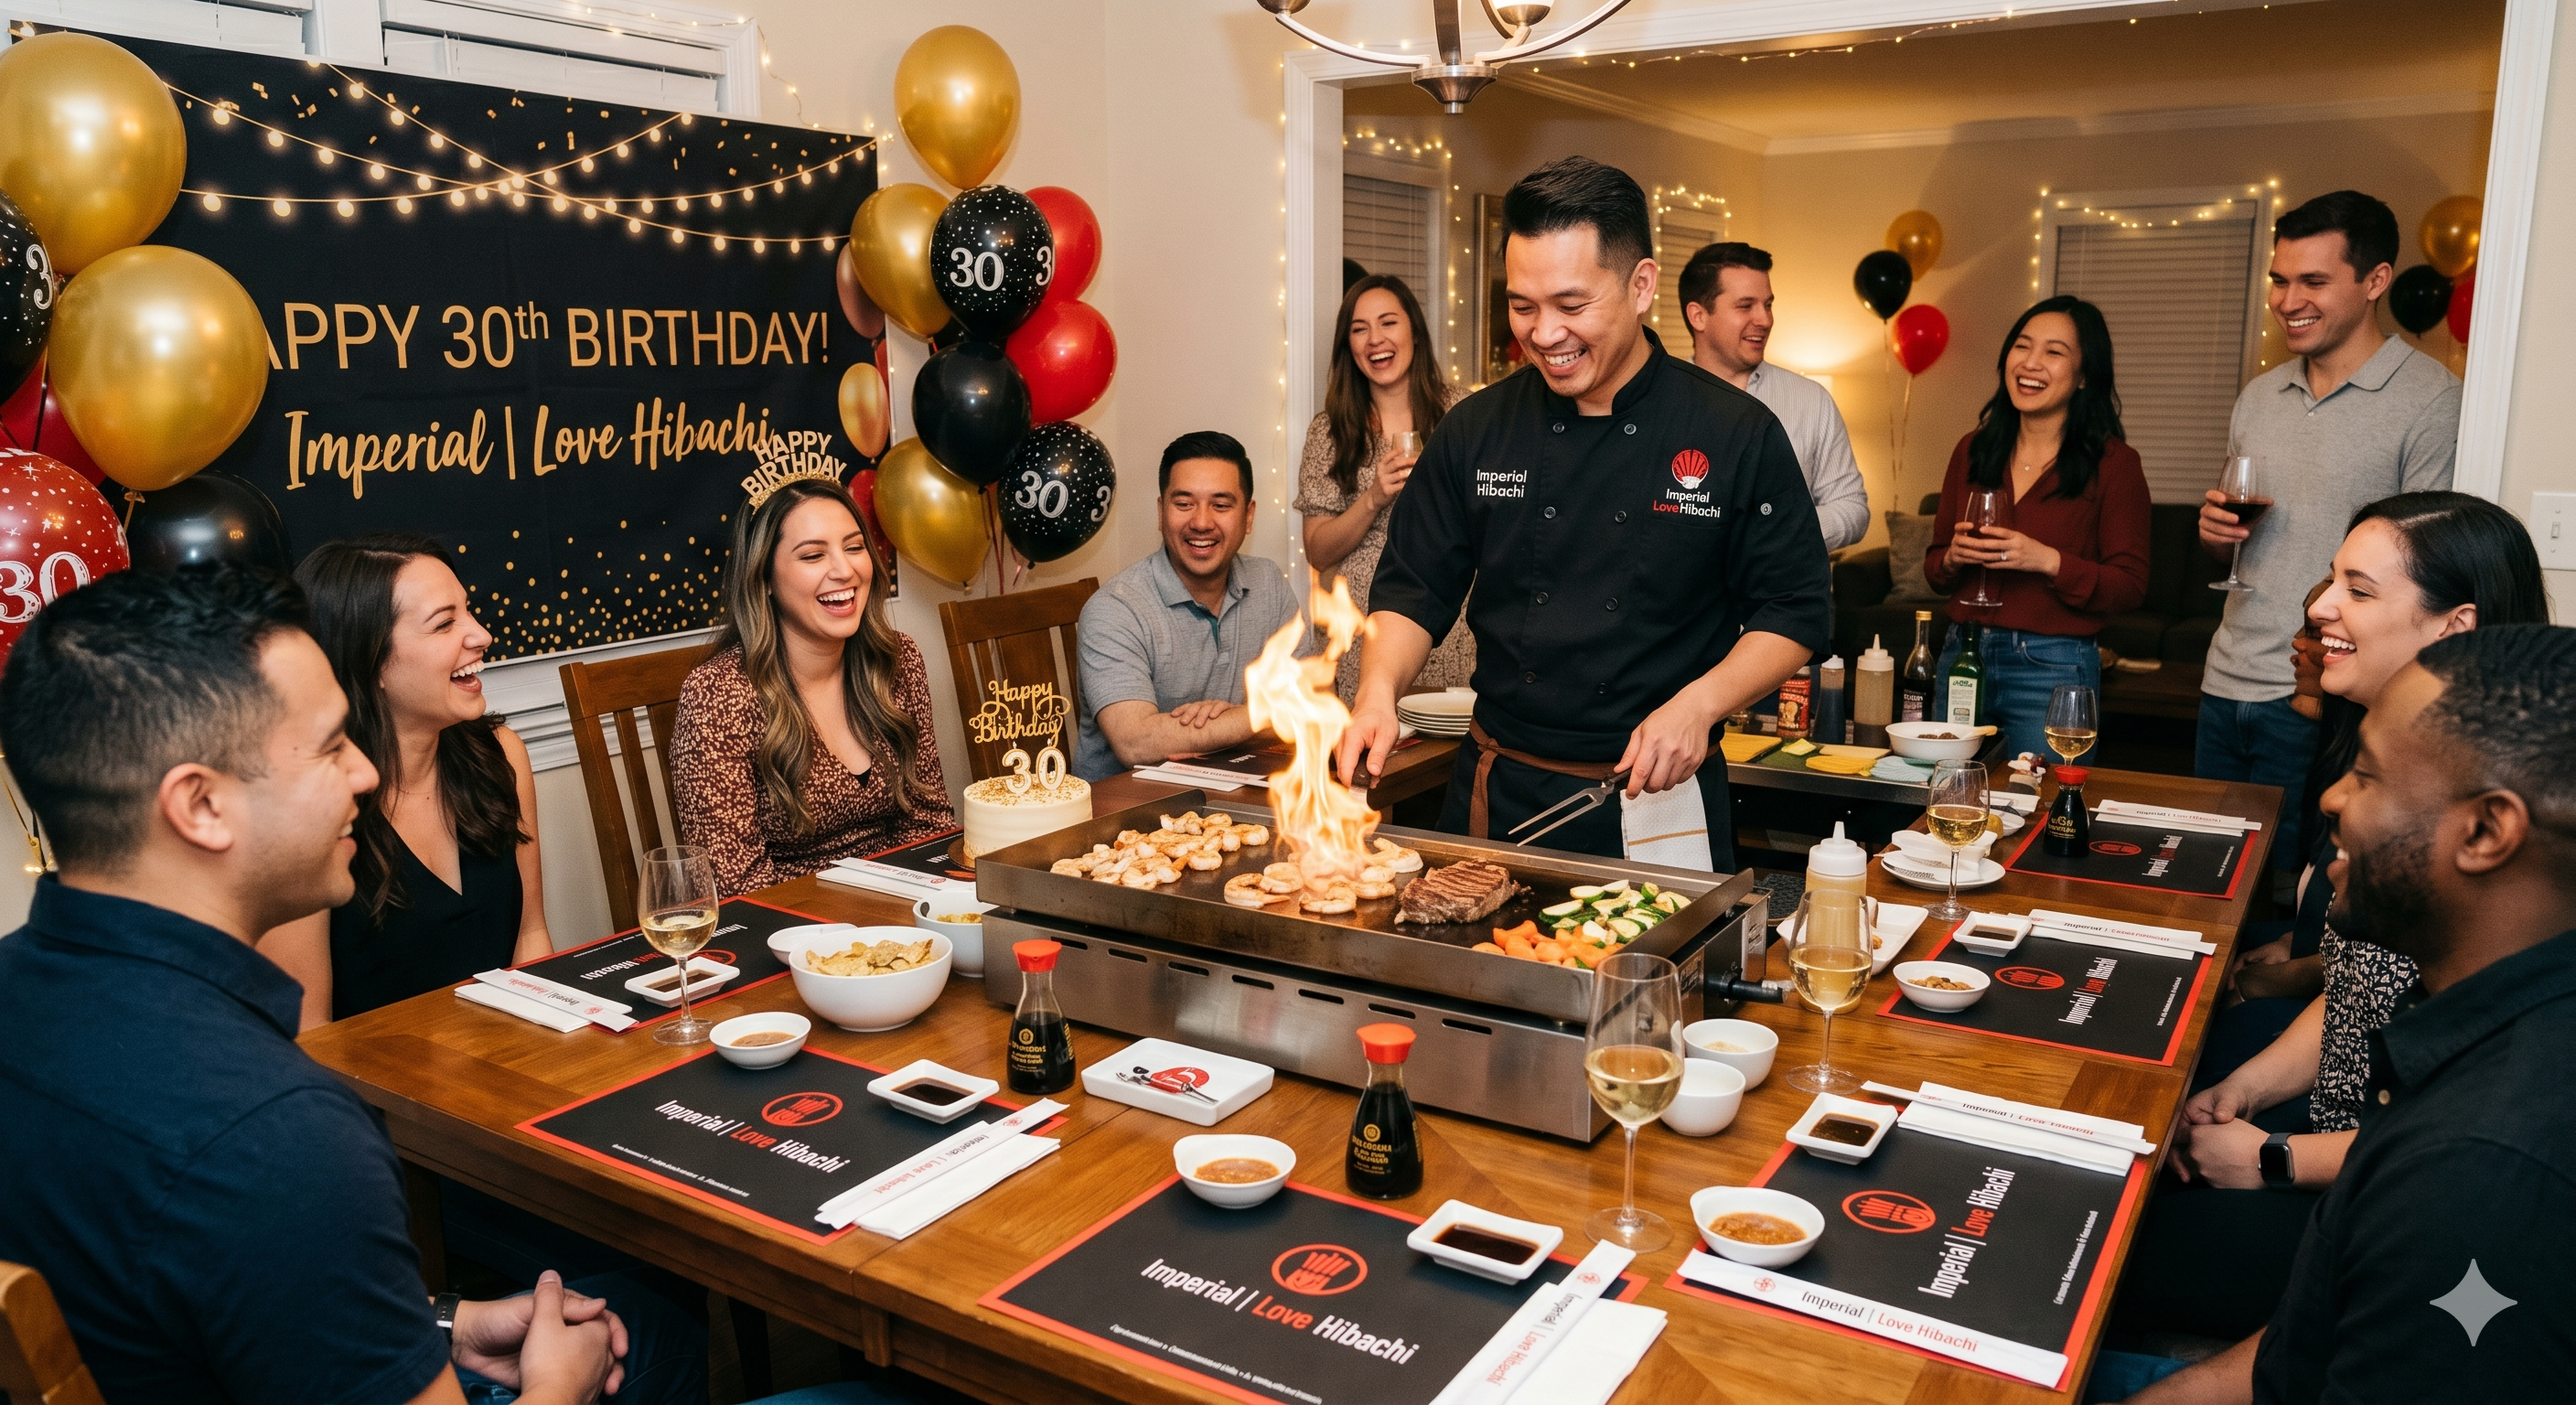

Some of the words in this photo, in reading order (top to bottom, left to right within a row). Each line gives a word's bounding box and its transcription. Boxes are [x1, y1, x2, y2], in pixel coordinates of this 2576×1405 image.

[26, 243, 54, 309] 3
[950, 247, 1004, 292] 30
[1036, 245, 1055, 286] 3
[263, 303, 420, 370] PPY
[441, 301, 549, 369] 30th
[567, 307, 828, 367] BIRTHDAY!
[284, 409, 495, 499] Imperial
[533, 404, 623, 477] Love
[629, 397, 775, 471] Hibachi
[752, 430, 832, 465] HAPPY
[741, 452, 847, 497] BIRTHDAY
[1015, 470, 1068, 519] 30
[1476, 468, 1528, 484] Imperial
[1476, 483, 1525, 498] Hibachi
[1666, 488, 1710, 503] Imperial
[1090, 485, 1116, 522] 3
[981, 679, 1071, 720] Happy
[969, 712, 1064, 749] Birthday
[1002, 746, 1067, 795] 30
[729, 1126, 778, 1148] Love
[769, 1139, 851, 1174] Hibachi
[1966, 1166, 2016, 1209] Hibachi
[1950, 1208, 1995, 1238] Love
[1917, 1240, 1977, 1299] Imperial
[1141, 1259, 1246, 1305] Imperial
[1251, 1294, 1315, 1330] Love
[1312, 1314, 1421, 1366] Hibachi
[1801, 1291, 1865, 1318] Imperial
[1877, 1313, 1914, 1333] Love
[1916, 1324, 1980, 1353] Hibachi
